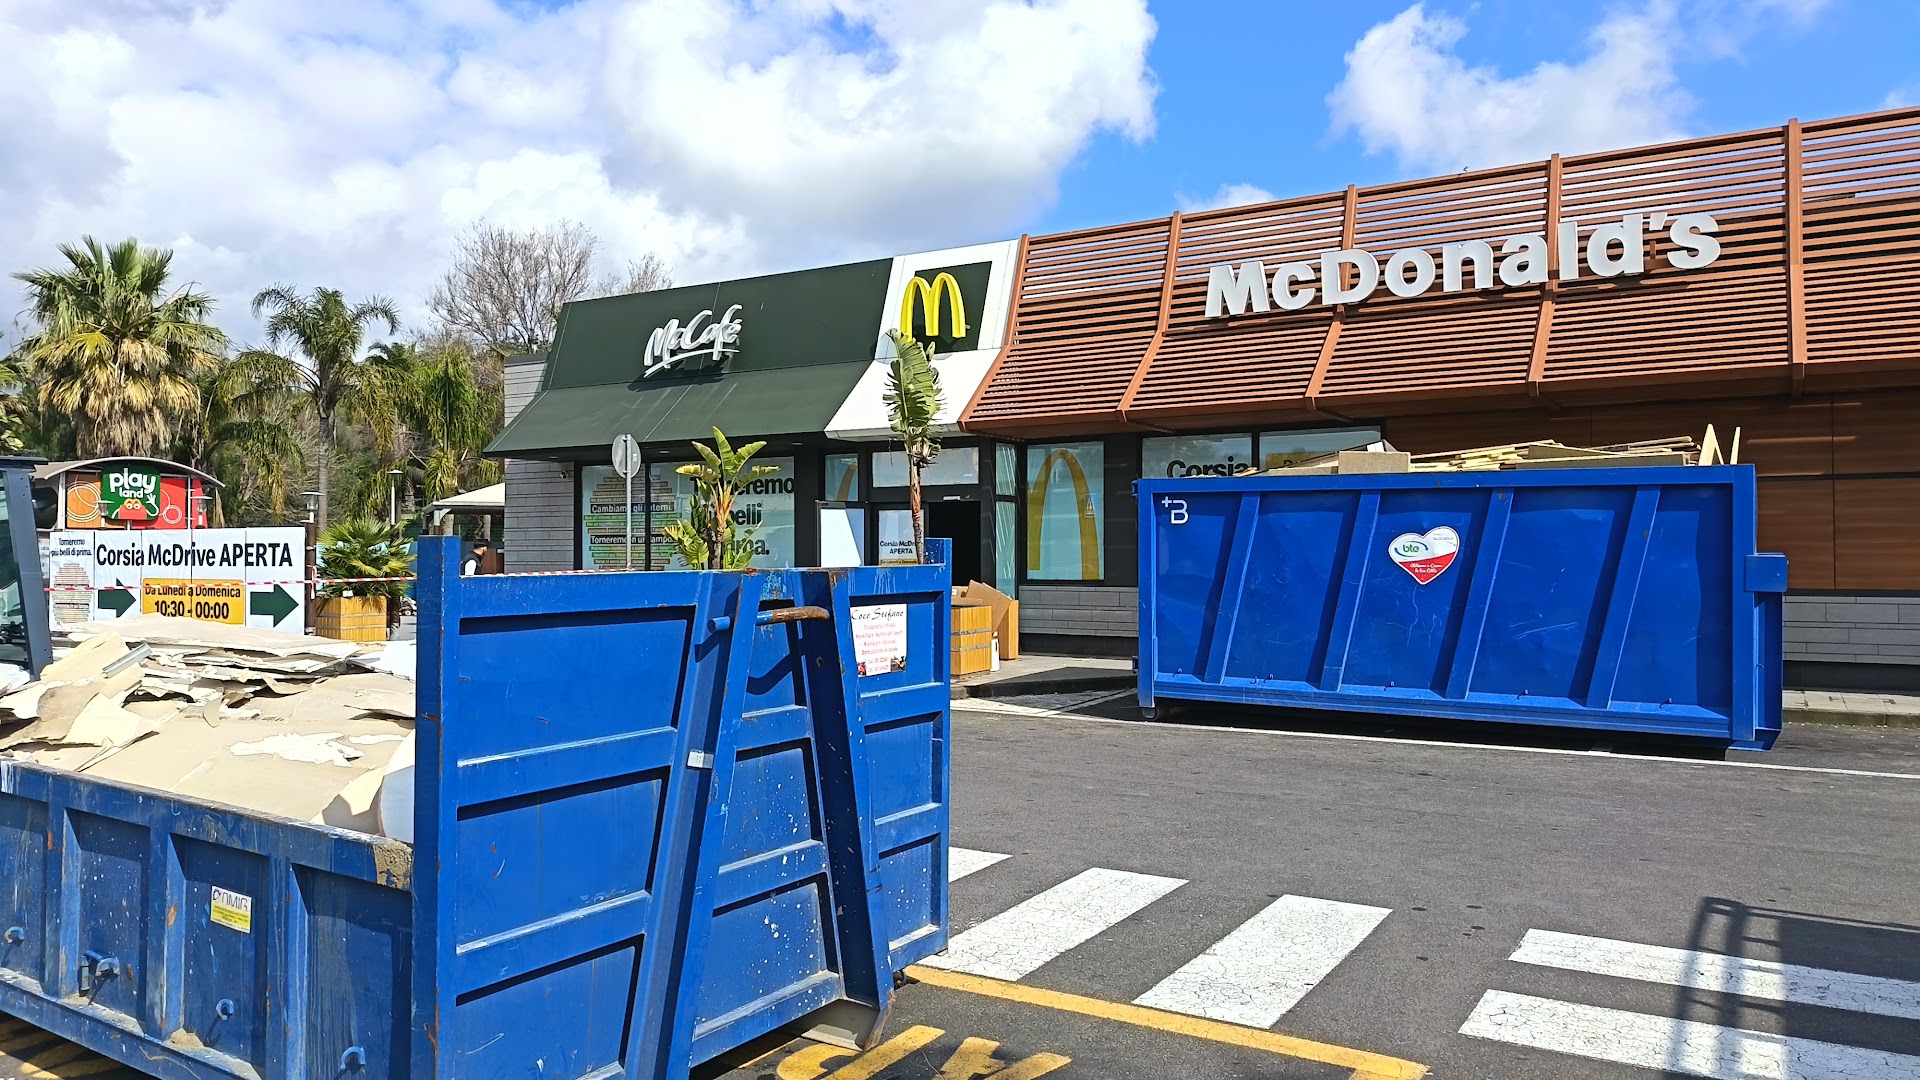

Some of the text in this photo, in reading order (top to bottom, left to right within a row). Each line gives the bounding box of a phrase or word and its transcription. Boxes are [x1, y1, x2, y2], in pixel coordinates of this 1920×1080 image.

[1204, 212, 1722, 317] McDonald's
[643, 304, 742, 370] McCafé
[109, 467, 156, 494] play
[119, 486, 144, 499] land
[591, 502, 631, 514] Cambiam
[96, 541, 292, 567] Corsia McDrive APERTA
[1402, 544, 1420, 553] bte
[145, 583, 156, 596] Da
[195, 585, 241, 598] Domenica
[154, 600, 185, 617] 10:30
[194, 601, 229, 619] 00:00
